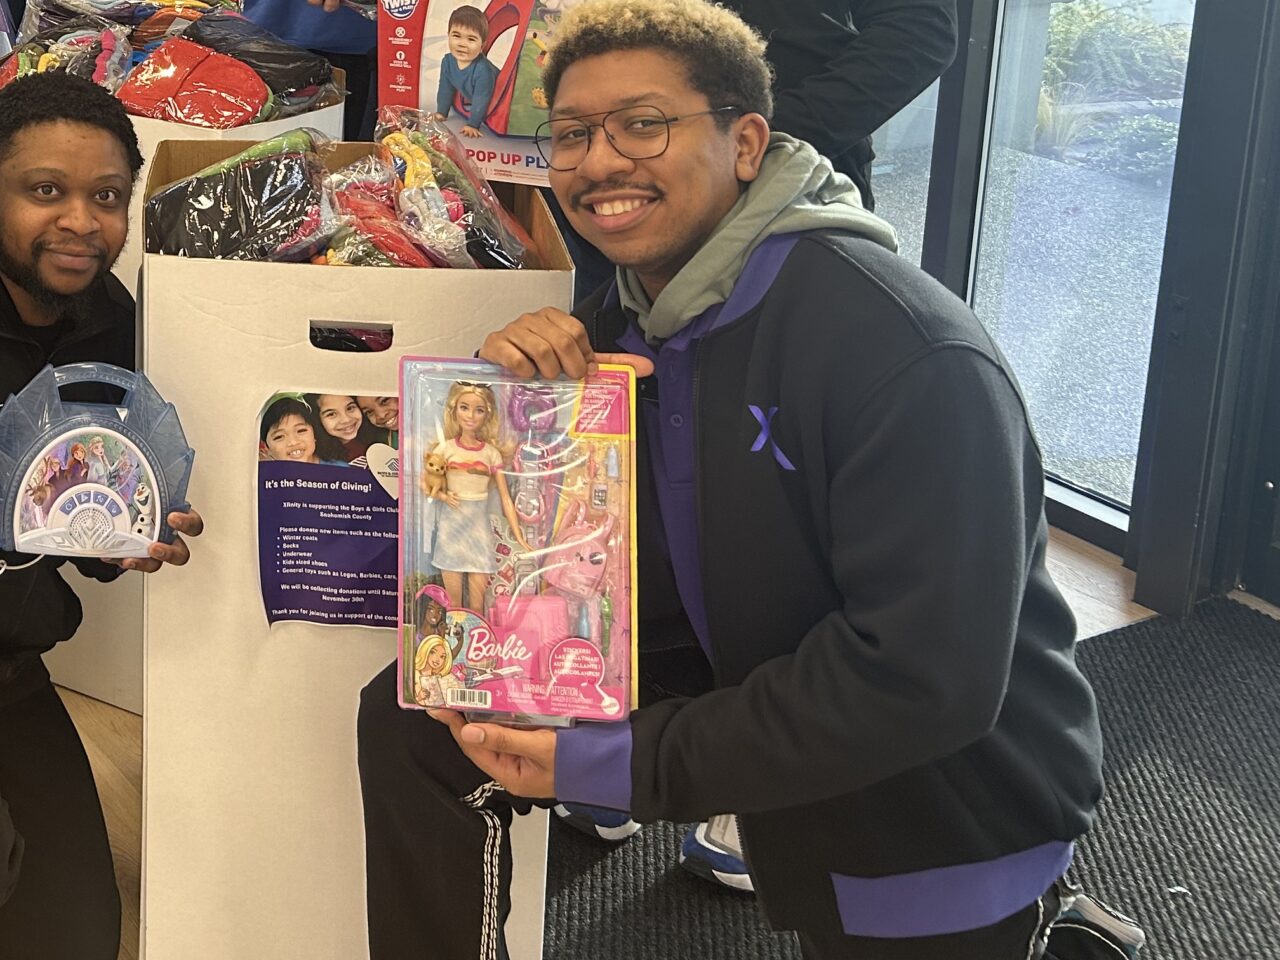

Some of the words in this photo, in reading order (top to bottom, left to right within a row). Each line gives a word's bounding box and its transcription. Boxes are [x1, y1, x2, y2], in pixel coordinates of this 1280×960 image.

[465, 148, 497, 163] POP
[500, 152, 522, 166] UP
[265, 480, 278, 489] It's
[280, 479, 295, 488] the
[296, 479, 328, 490] Season
[330, 481, 340, 490] of
[341, 481, 372, 493] Giving!
[308, 502, 339, 512] supporting
[351, 505, 365, 513] Boys
[320, 511, 351, 520] Snohomish
[352, 513, 372, 521] County
[279, 526, 298, 534] Please
[299, 526, 319, 534] donate
[349, 529, 363, 537] such
[372, 530, 382, 538] the
[311, 560, 328, 568] shoes
[340, 571, 359, 579] Legos,
[359, 572, 383, 580] Barbies,
[310, 584, 338, 594] collecting
[321, 594, 351, 602] November
[288, 608, 299, 616] you
[309, 609, 328, 619] joining
[468, 628, 532, 661] Barbie
